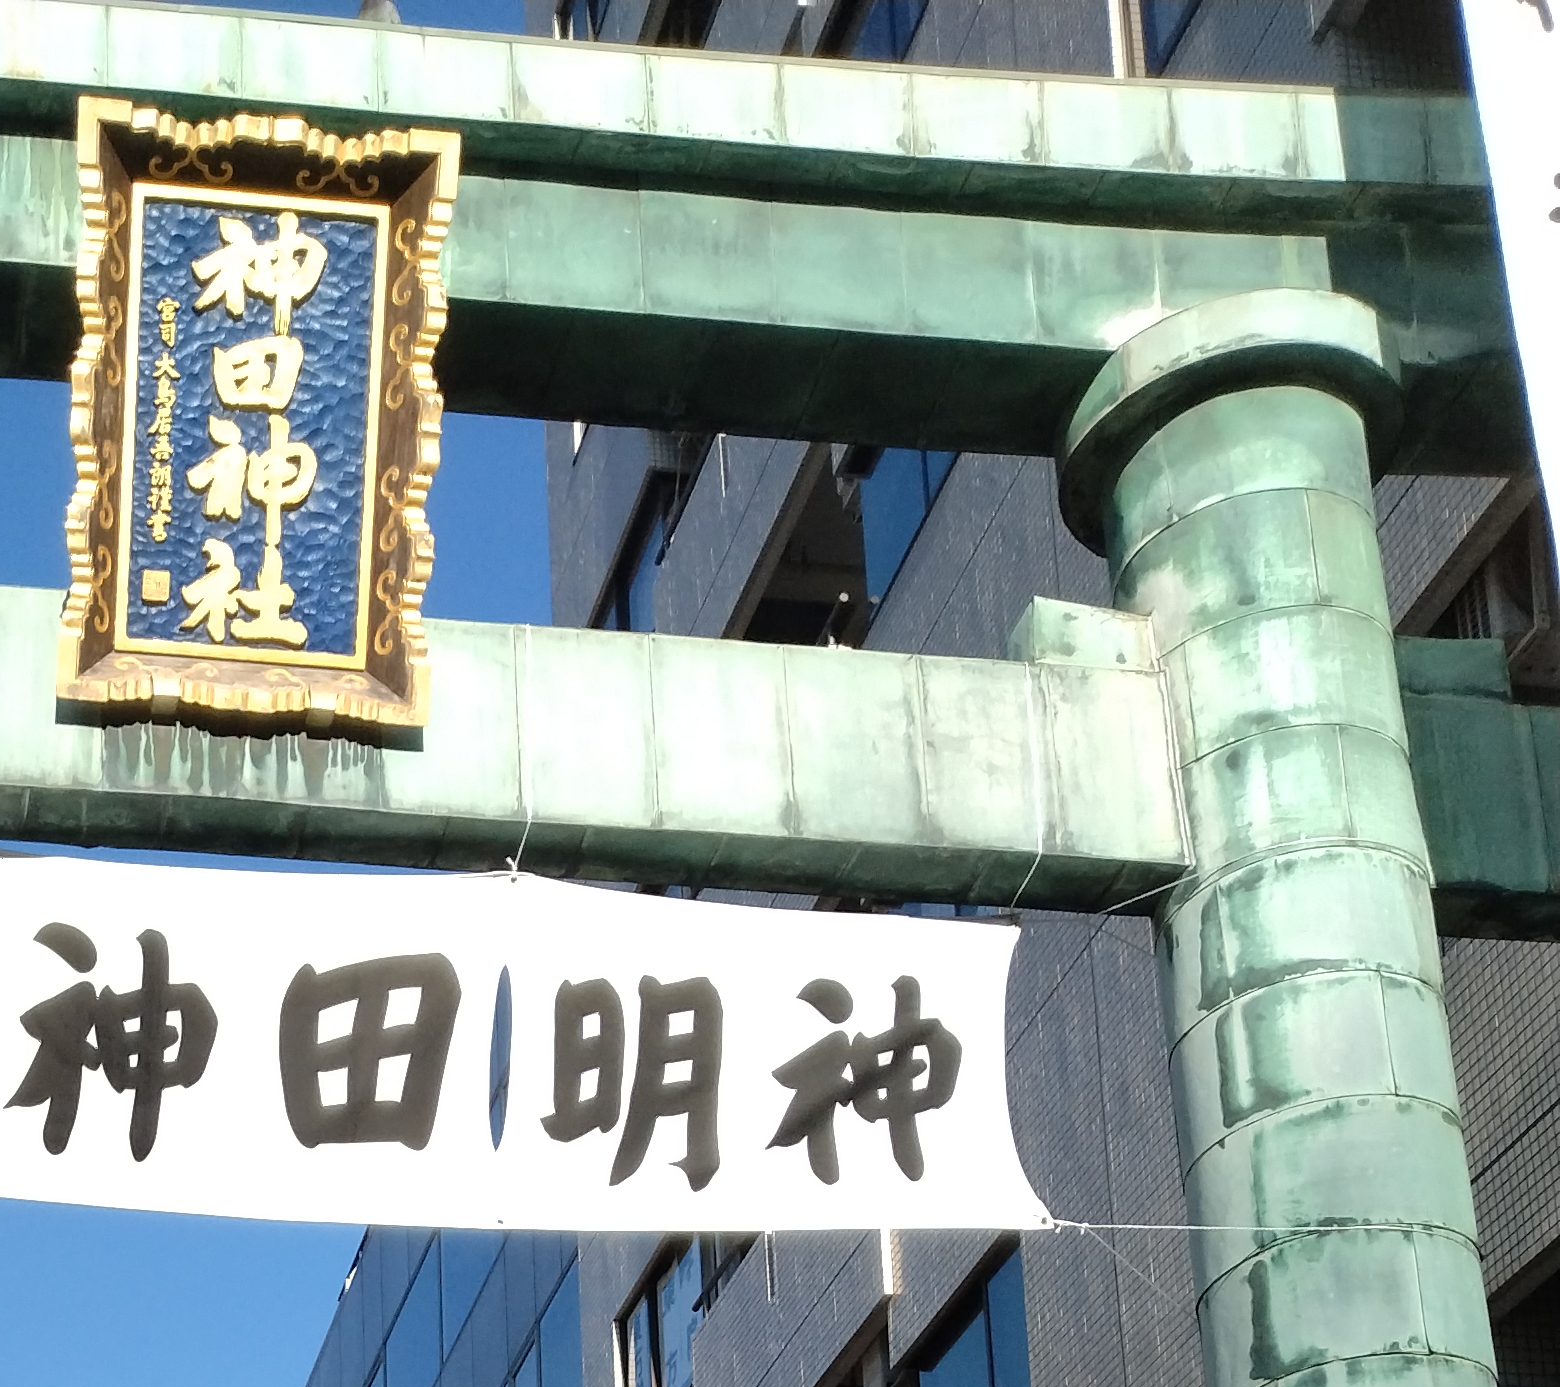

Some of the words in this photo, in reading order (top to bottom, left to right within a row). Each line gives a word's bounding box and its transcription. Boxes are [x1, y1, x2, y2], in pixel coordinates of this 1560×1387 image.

[182, 212, 328, 648] 神田神社
[1, 921, 964, 1192] 神田明神
